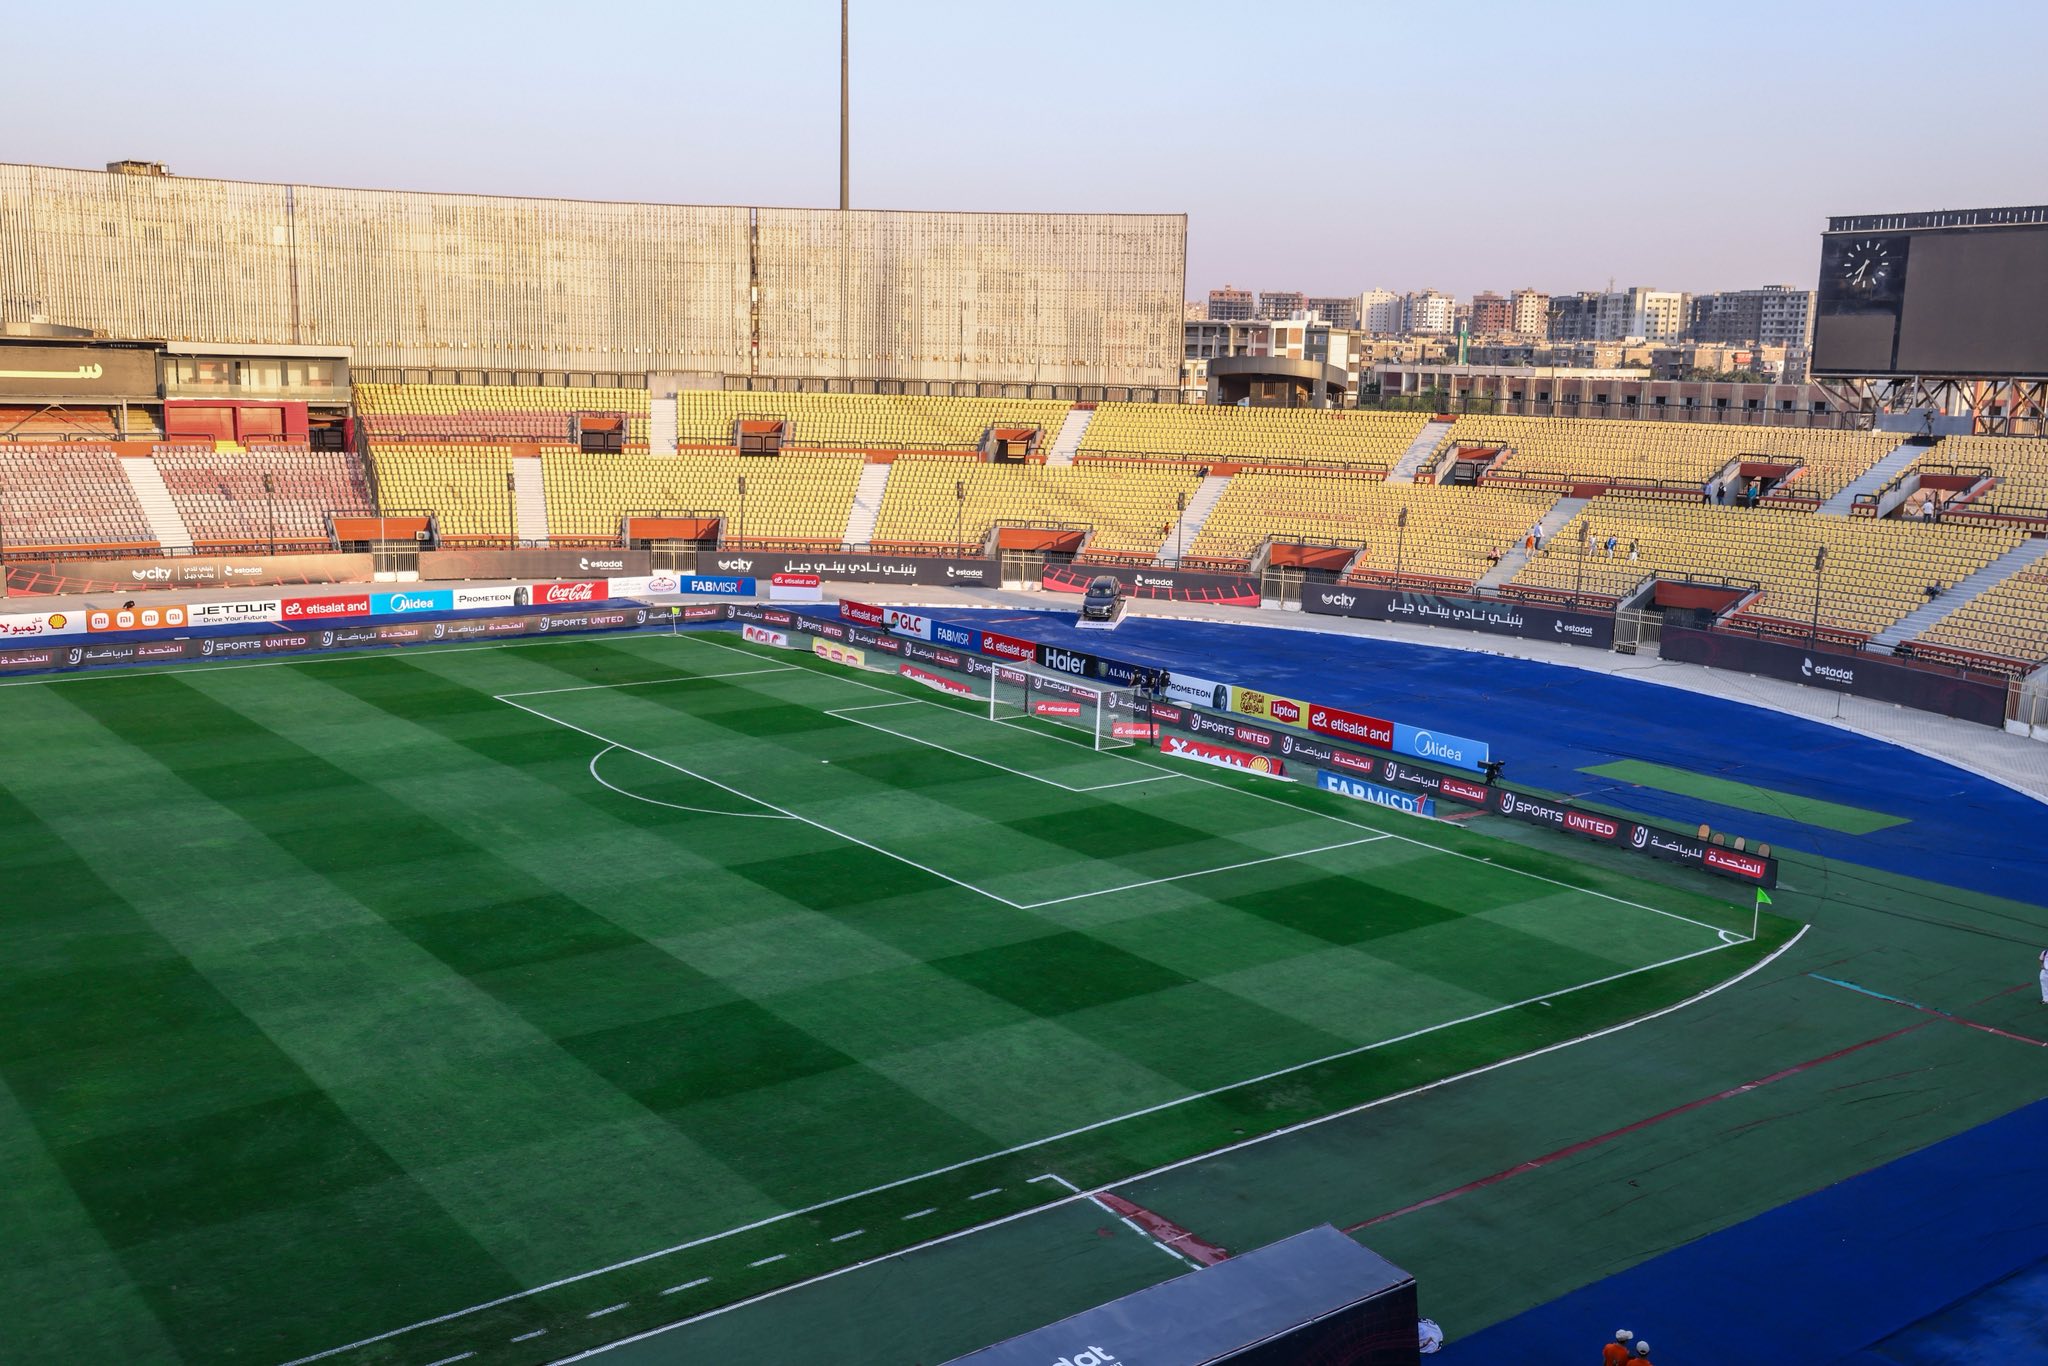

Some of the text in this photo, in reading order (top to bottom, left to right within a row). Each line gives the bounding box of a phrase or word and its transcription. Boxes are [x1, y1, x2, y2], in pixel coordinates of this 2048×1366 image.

[784, 560, 811, 573] جيل
[813, 562, 846, 573] يبني
[848, 563, 880, 574] نادي
[691, 580, 737, 593] FABMISR
[784, 577, 804, 585] etisalat
[547, 583, 594, 602] Coca-Cola
[395, 596, 434, 610] Midea
[1333, 593, 1356, 607] city
[1388, 598, 1414, 614] جيل
[193, 603, 276, 616] JETOUR
[306, 603, 345, 614] etisalat
[347, 601, 367, 613] and
[851, 608, 870, 621] etisalat
[1417, 604, 1450, 618] يبني
[551, 615, 624, 627] SPORTS UNITED
[1452, 609, 1485, 622] نادي
[803, 621, 842, 637] SPORTS UNITED
[900, 614, 921, 632] GLC
[1564, 623, 1593, 635] estadat
[937, 627, 968, 646] FABMISR
[216, 637, 306, 651] SPORTS UNITED
[995, 639, 1020, 656] etisalat
[1021, 647, 1034, 660] and
[1045, 648, 1086, 674] Haier
[1001, 669, 1025, 682] UNITED
[1814, 665, 1854, 680] estadat
[1273, 703, 1298, 719] Lipton
[1201, 720, 1270, 746] SPORTS UNITED
[1331, 719, 1367, 738] etisalat
[1369, 729, 1390, 743] and
[1417, 735, 1462, 761] Midea
[1295, 743, 1371, 770] المتحدة للرياضة
[1399, 767, 1484, 800] المتحدة للرياضة
[1516, 801, 1614, 836] SPORTS UNITED
[1651, 835, 1760, 874] المتحدة للرياضة
